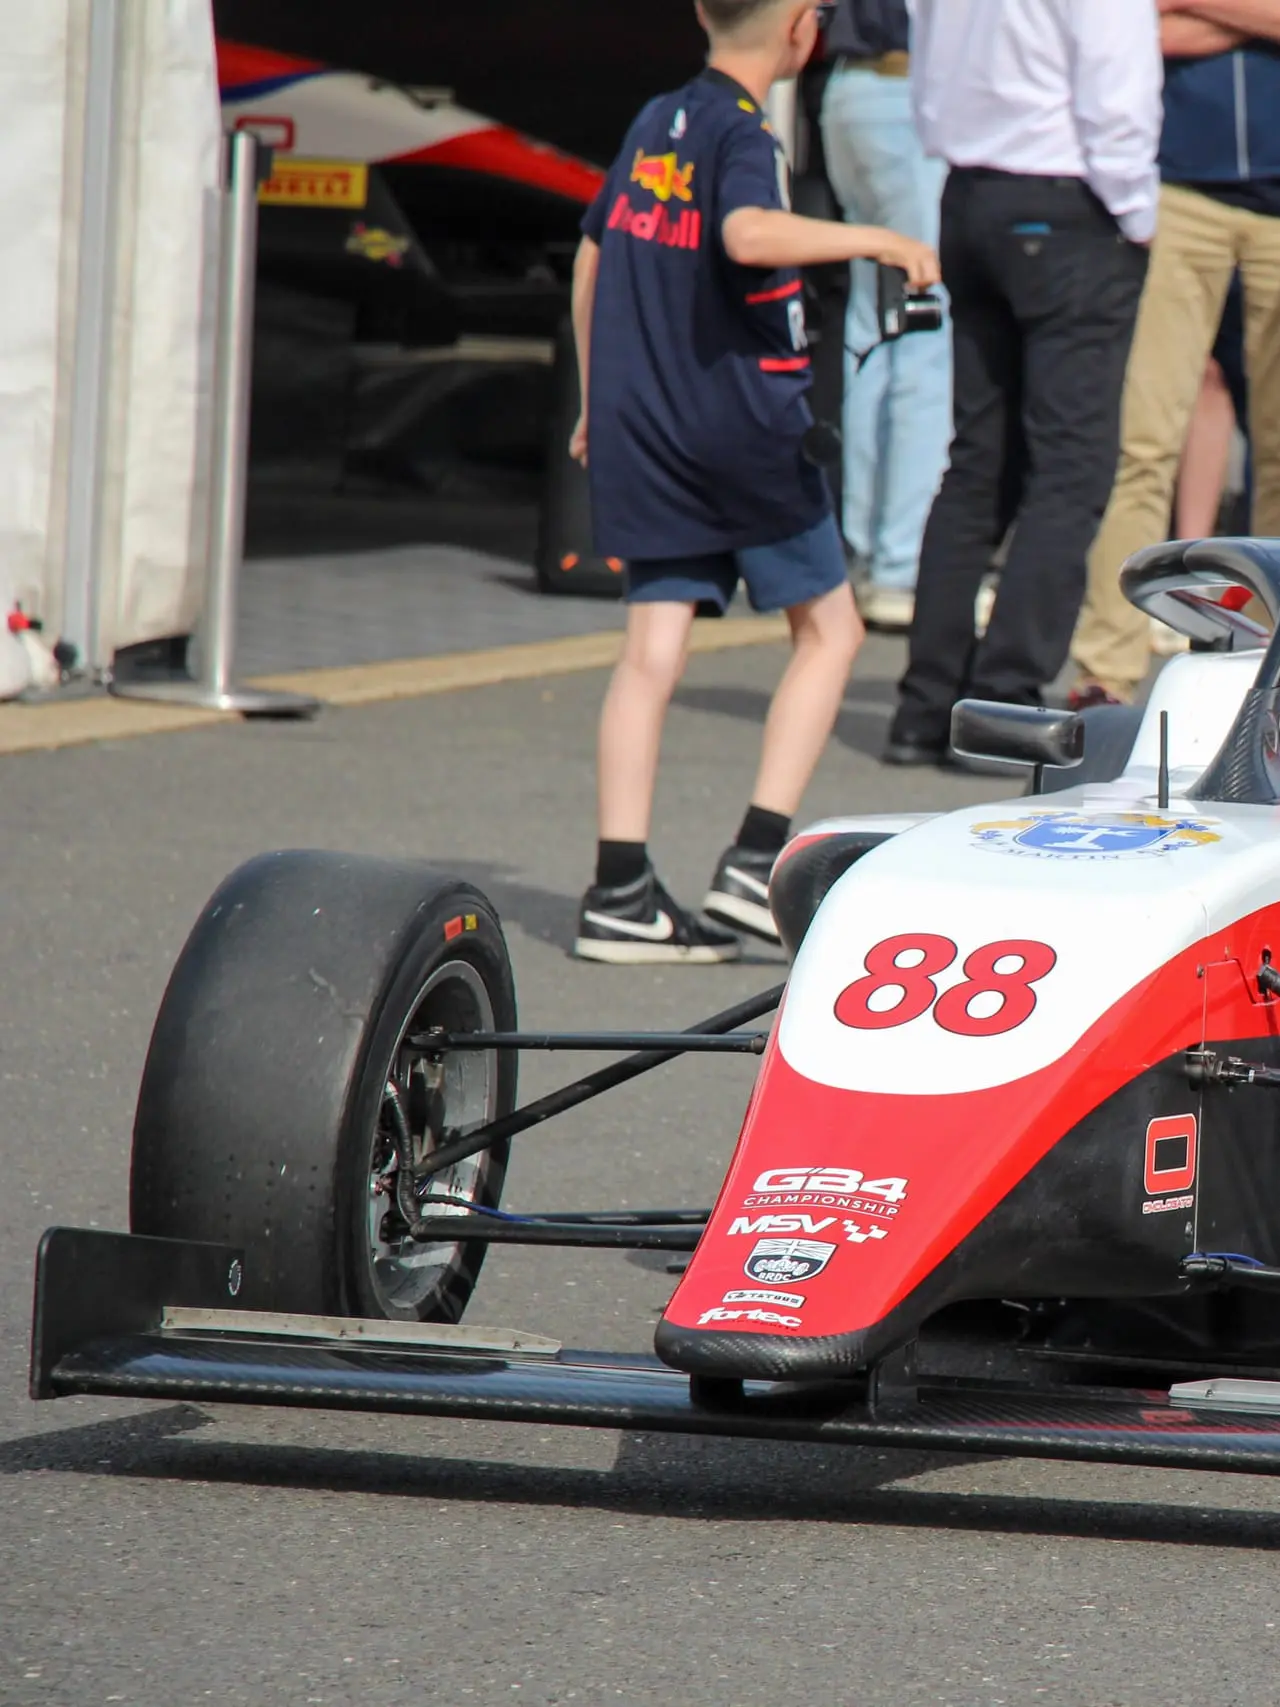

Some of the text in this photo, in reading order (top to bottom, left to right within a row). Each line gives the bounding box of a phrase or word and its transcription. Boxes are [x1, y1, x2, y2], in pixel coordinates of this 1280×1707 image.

[833, 932, 1058, 1038] 88
[752, 1167, 909, 1203] GB4
[743, 1193, 900, 1217] CHAMPIONSHIP
[726, 1213, 838, 1237] MSV
[757, 1271, 792, 1282] BRDC
[696, 1306, 803, 1328] fortec
